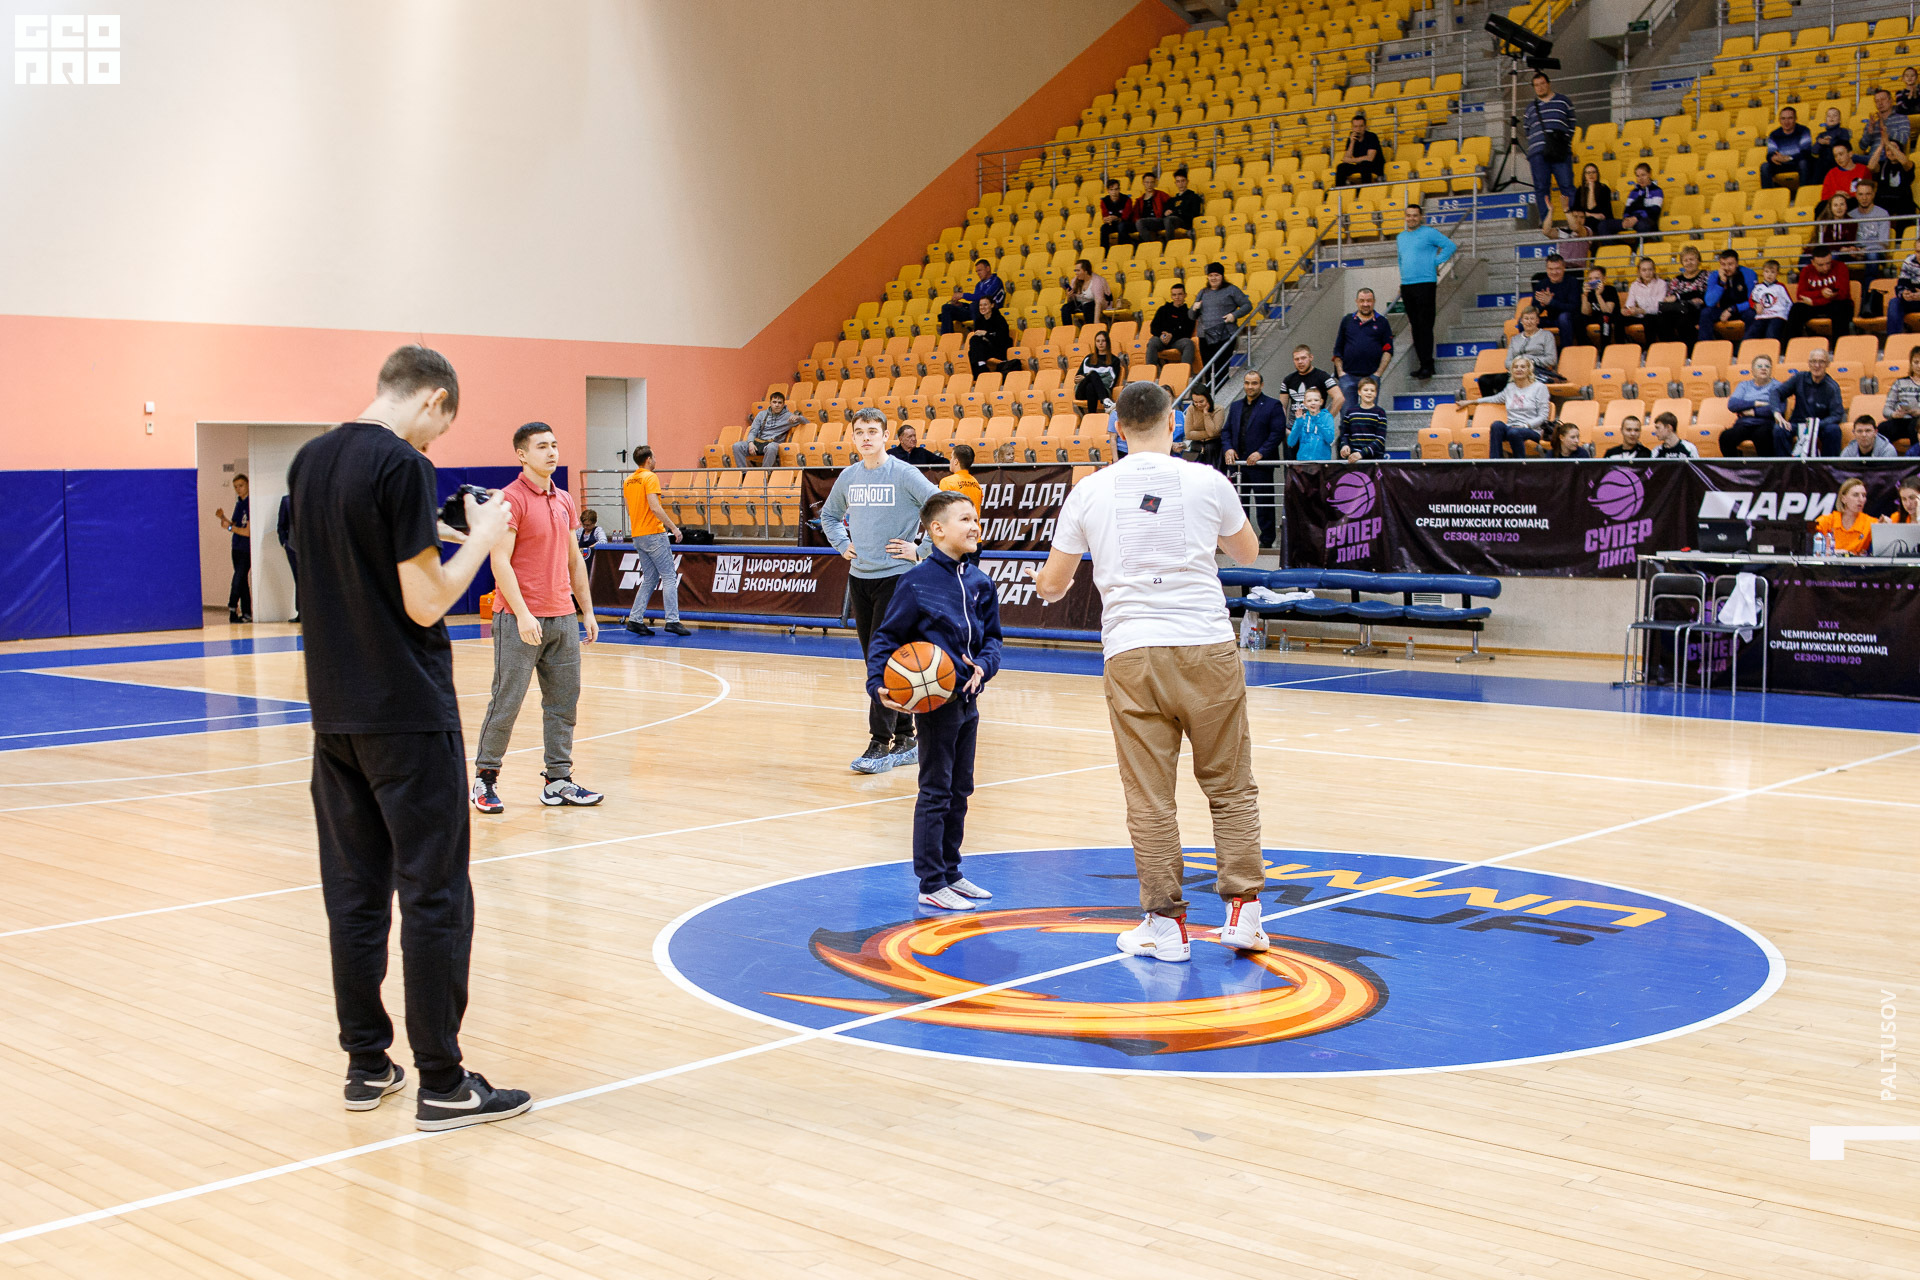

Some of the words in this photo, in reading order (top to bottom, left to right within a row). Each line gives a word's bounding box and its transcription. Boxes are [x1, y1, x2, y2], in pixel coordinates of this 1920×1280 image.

[849, 486, 892, 504] TURNOUT
[1018, 482, 1067, 509] ДЛЯ
[1470, 490, 1495, 500] XXIX
[1428, 504, 1491, 514] ЧЕМПИОНАТ
[1492, 504, 1537, 514] РОССИИ
[1698, 490, 1838, 521] ПАРИ
[1415, 518, 1450, 528] СРЕДИ
[1451, 518, 1502, 528] МУЖСКИХ
[1503, 518, 1550, 530] КОМАНД
[1325, 516, 1382, 549] СУПЕР
[1443, 532, 1478, 541] СЕЗОН
[1479, 532, 1520, 542] 2019/20
[1584, 518, 1653, 553] СУПЕР
[1336, 542, 1370, 563] ЛИГА
[1597, 546, 1636, 569] ЛИГА
[745, 556, 813, 575] ЦИФРОВОЙ
[742, 577, 818, 593] ЭКОНОМИКИ
[1152, 577, 1163, 585] 23
[1817, 620, 1840, 629] XXIX
[1780, 629, 1836, 641] ЧЕМПИОНАТ
[1837, 632, 1878, 643] РОССИИ
[1769, 640, 1800, 651] СРЕДИ
[1801, 641, 1846, 652] МУЖСКИХ
[1847, 644, 1889, 656] КОМАНД
[1793, 653, 1824, 662] СЕЗОН
[1825, 655, 1862, 664] 2019/20
